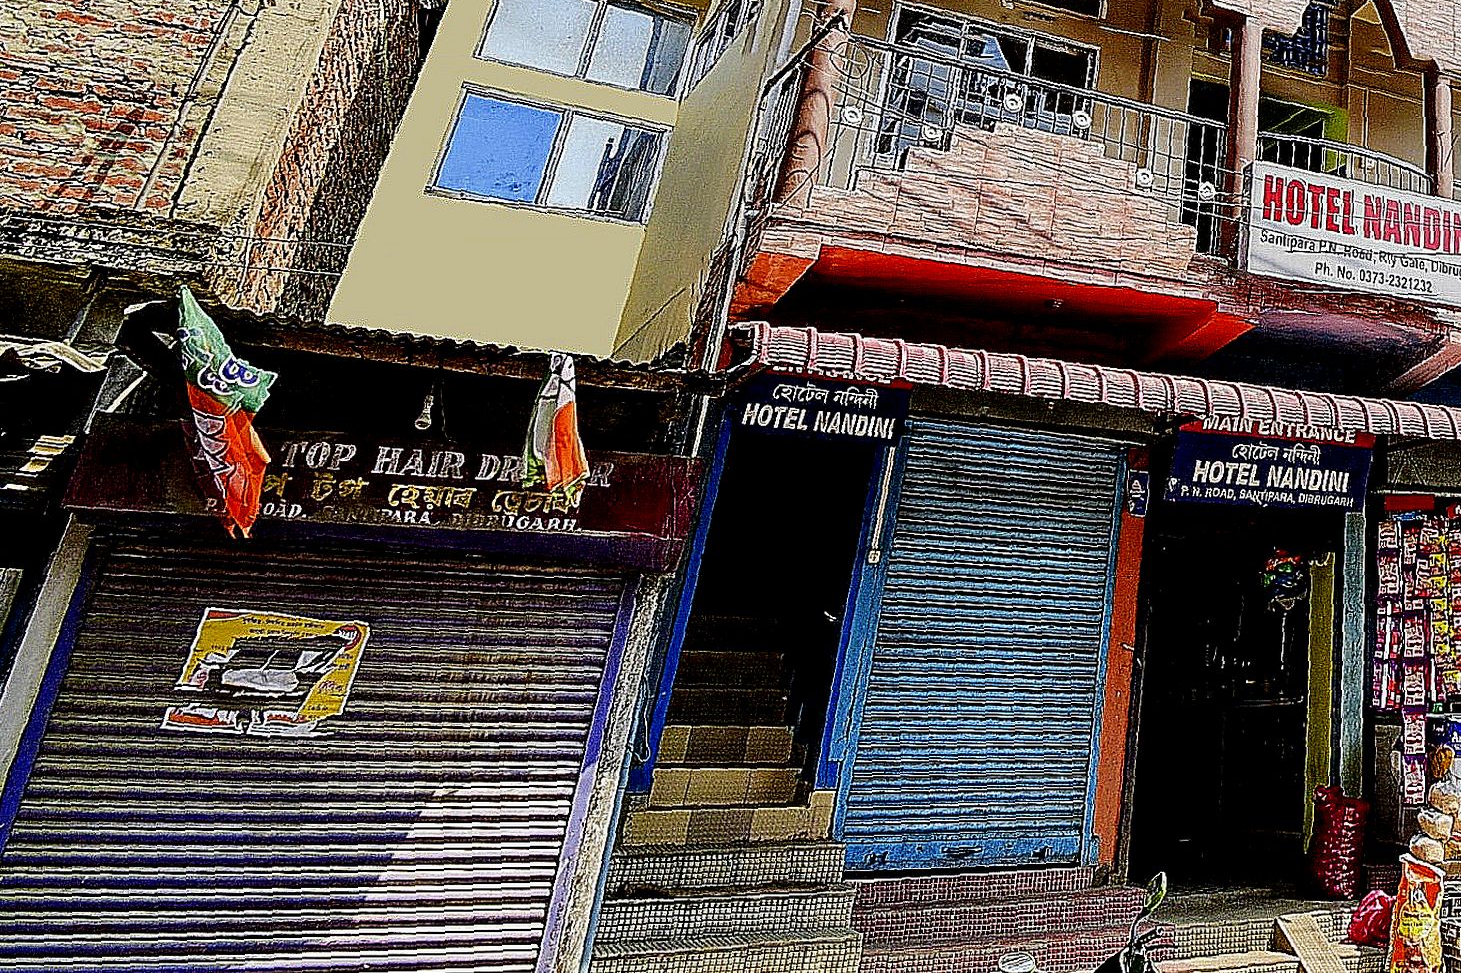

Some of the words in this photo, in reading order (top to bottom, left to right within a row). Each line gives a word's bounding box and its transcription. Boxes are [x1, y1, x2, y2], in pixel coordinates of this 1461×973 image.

[1262, 175, 1356, 235] HOTEL
[1260, 229, 1315, 252] Santipara
[1314, 261, 1333, 277] Ph.
[1337, 265, 1356, 281] No.
[1359, 268, 1433, 293] 0373-2321232
[741, 402, 808, 431] HOTEL
[812, 410, 896, 440] NANDINI
[1202, 415, 1252, 433] MAIN
[1258, 419, 1357, 444] ENTRANCE
[281, 441, 357, 470] TOP
[371, 445, 465, 479] HAIR
[1192, 459, 1261, 487] HOTEL
[1266, 464, 1350, 493] NANDINI
[1205, 487, 1237, 501] ROAD,
[1298, 493, 1354, 508] DIBRUGARH
